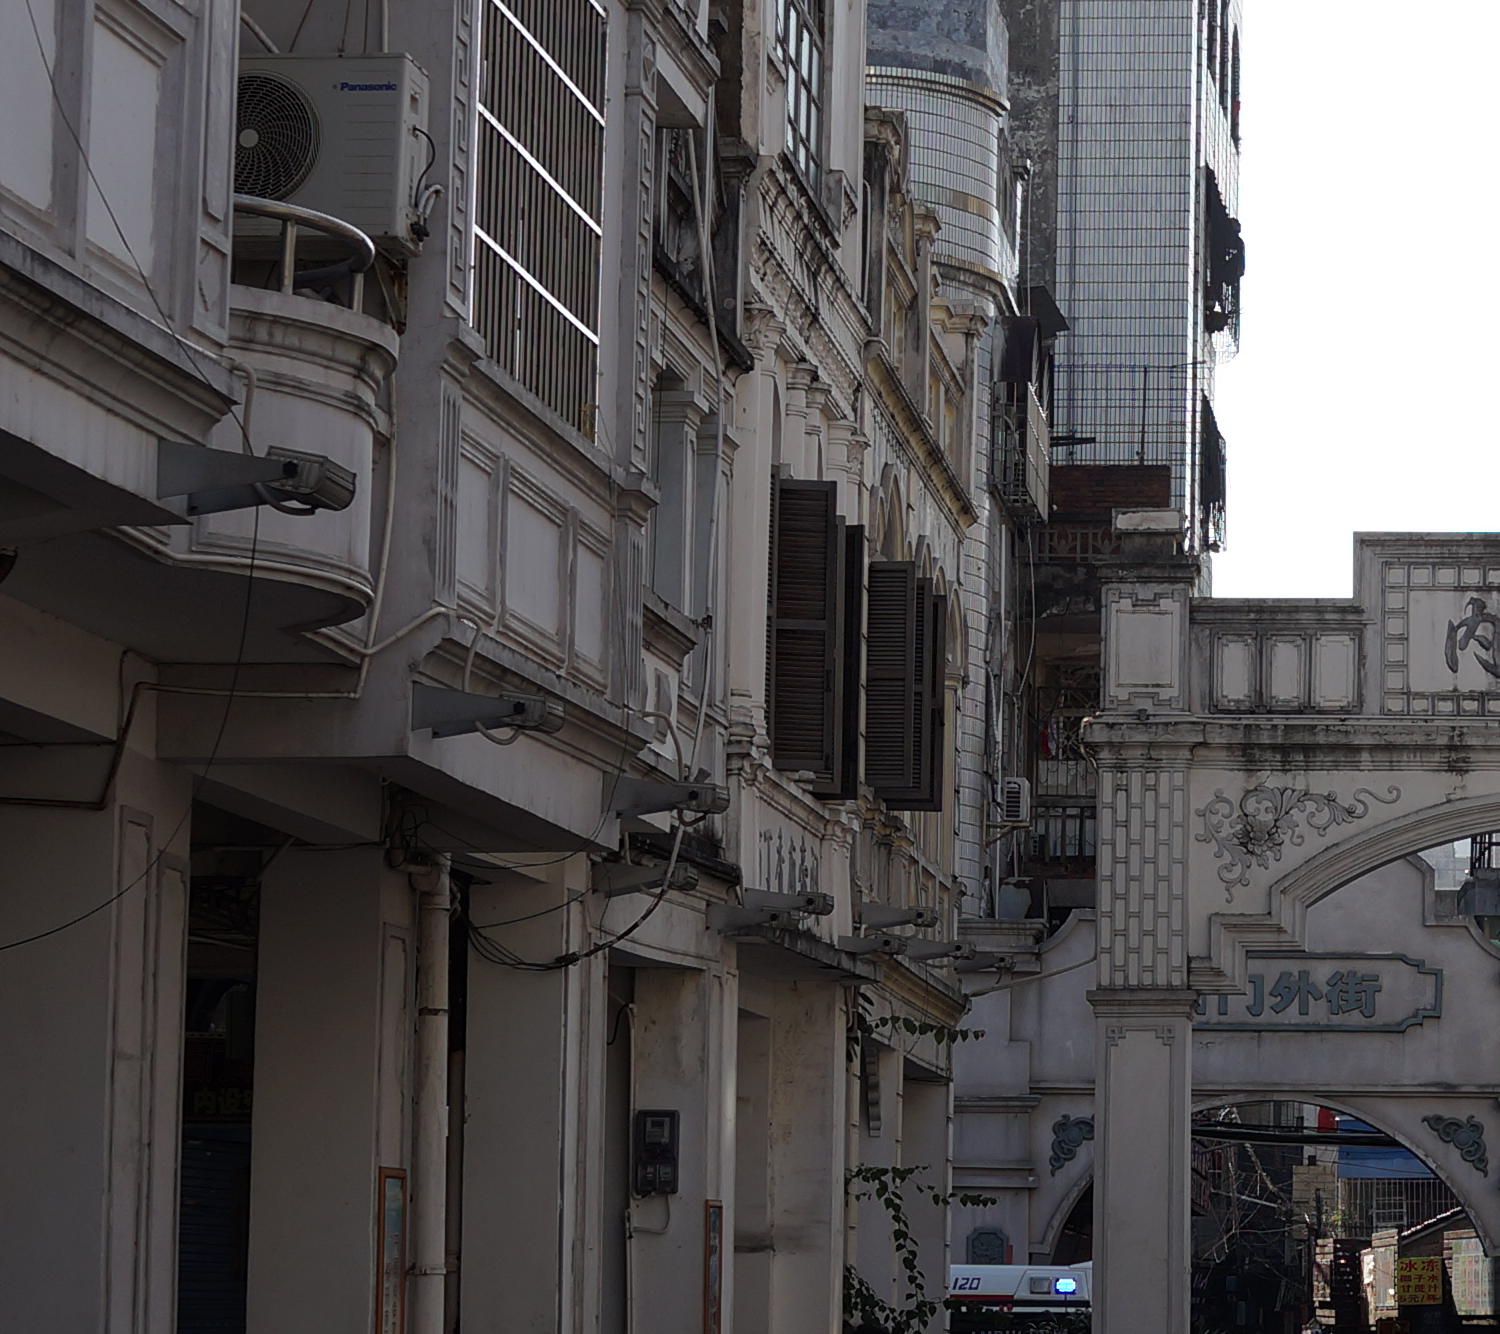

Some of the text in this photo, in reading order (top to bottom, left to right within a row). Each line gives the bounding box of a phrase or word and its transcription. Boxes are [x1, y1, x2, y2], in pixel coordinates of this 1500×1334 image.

[1195, 971, 1382, 1018] 门外街
[952, 1277, 981, 1291] 120
